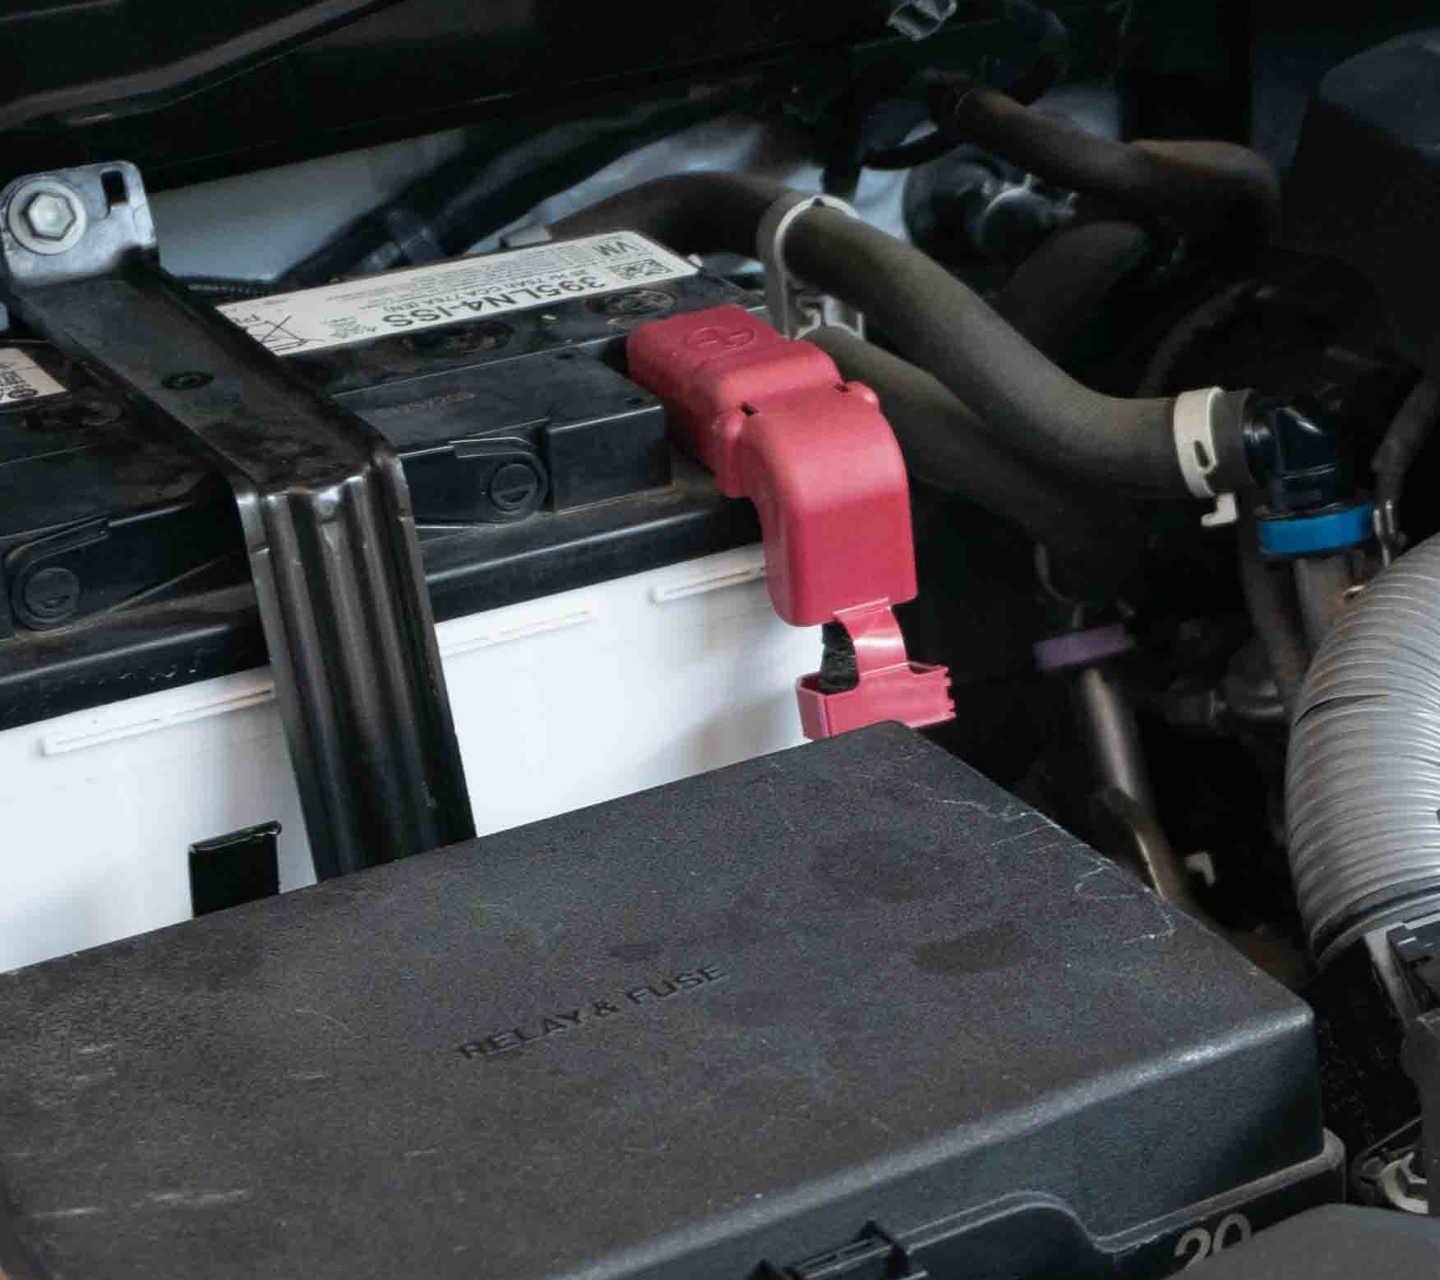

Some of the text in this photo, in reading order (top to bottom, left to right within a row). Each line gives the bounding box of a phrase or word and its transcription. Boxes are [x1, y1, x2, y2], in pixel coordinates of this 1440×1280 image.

[381, 278, 606, 329] 395LN4-ISS
[457, 963, 730, 1060] RELAY & FUSE
